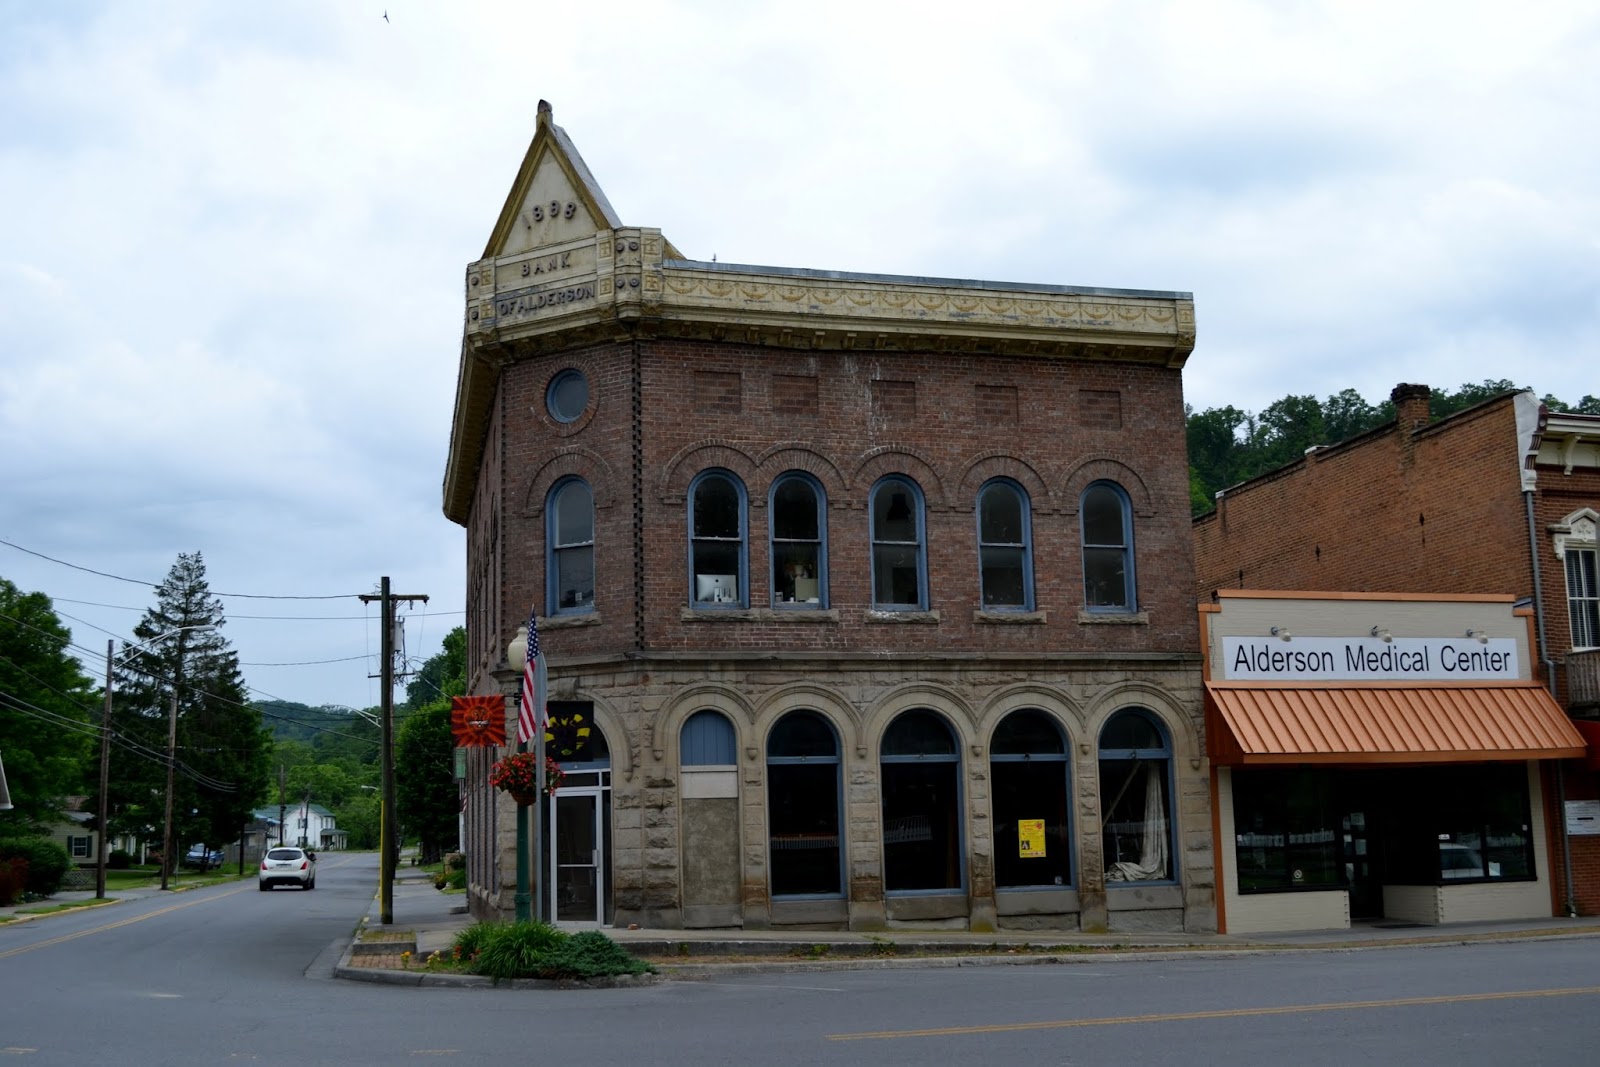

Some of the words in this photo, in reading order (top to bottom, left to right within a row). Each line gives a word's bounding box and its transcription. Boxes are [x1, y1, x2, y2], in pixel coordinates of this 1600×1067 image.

[522, 252, 571, 277] BANK
[1234, 644, 1335, 672] Alderson
[1345, 645, 1430, 672] Medical
[1440, 645, 1511, 672] Center
